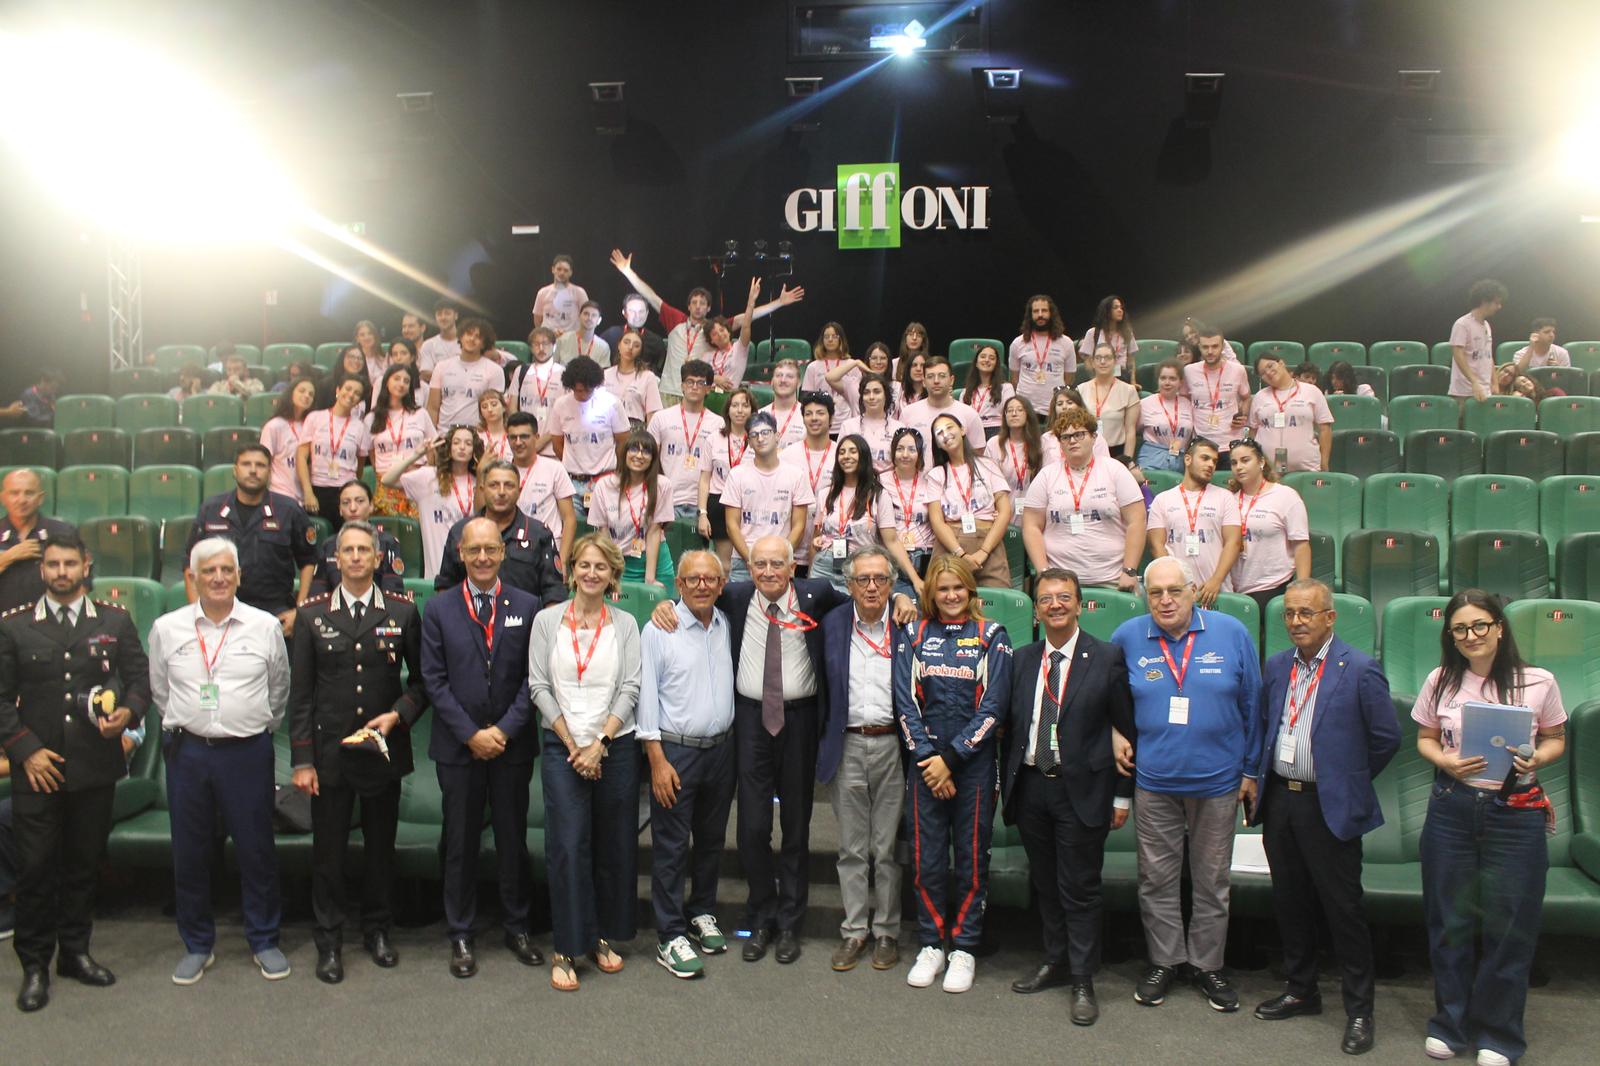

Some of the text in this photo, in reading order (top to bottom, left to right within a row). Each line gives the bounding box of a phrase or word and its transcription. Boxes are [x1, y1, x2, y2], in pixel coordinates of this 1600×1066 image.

[785, 171, 989, 232] GIffONI
[1015, 599, 1024, 607] 10
[1358, 606, 1364, 614] 7
